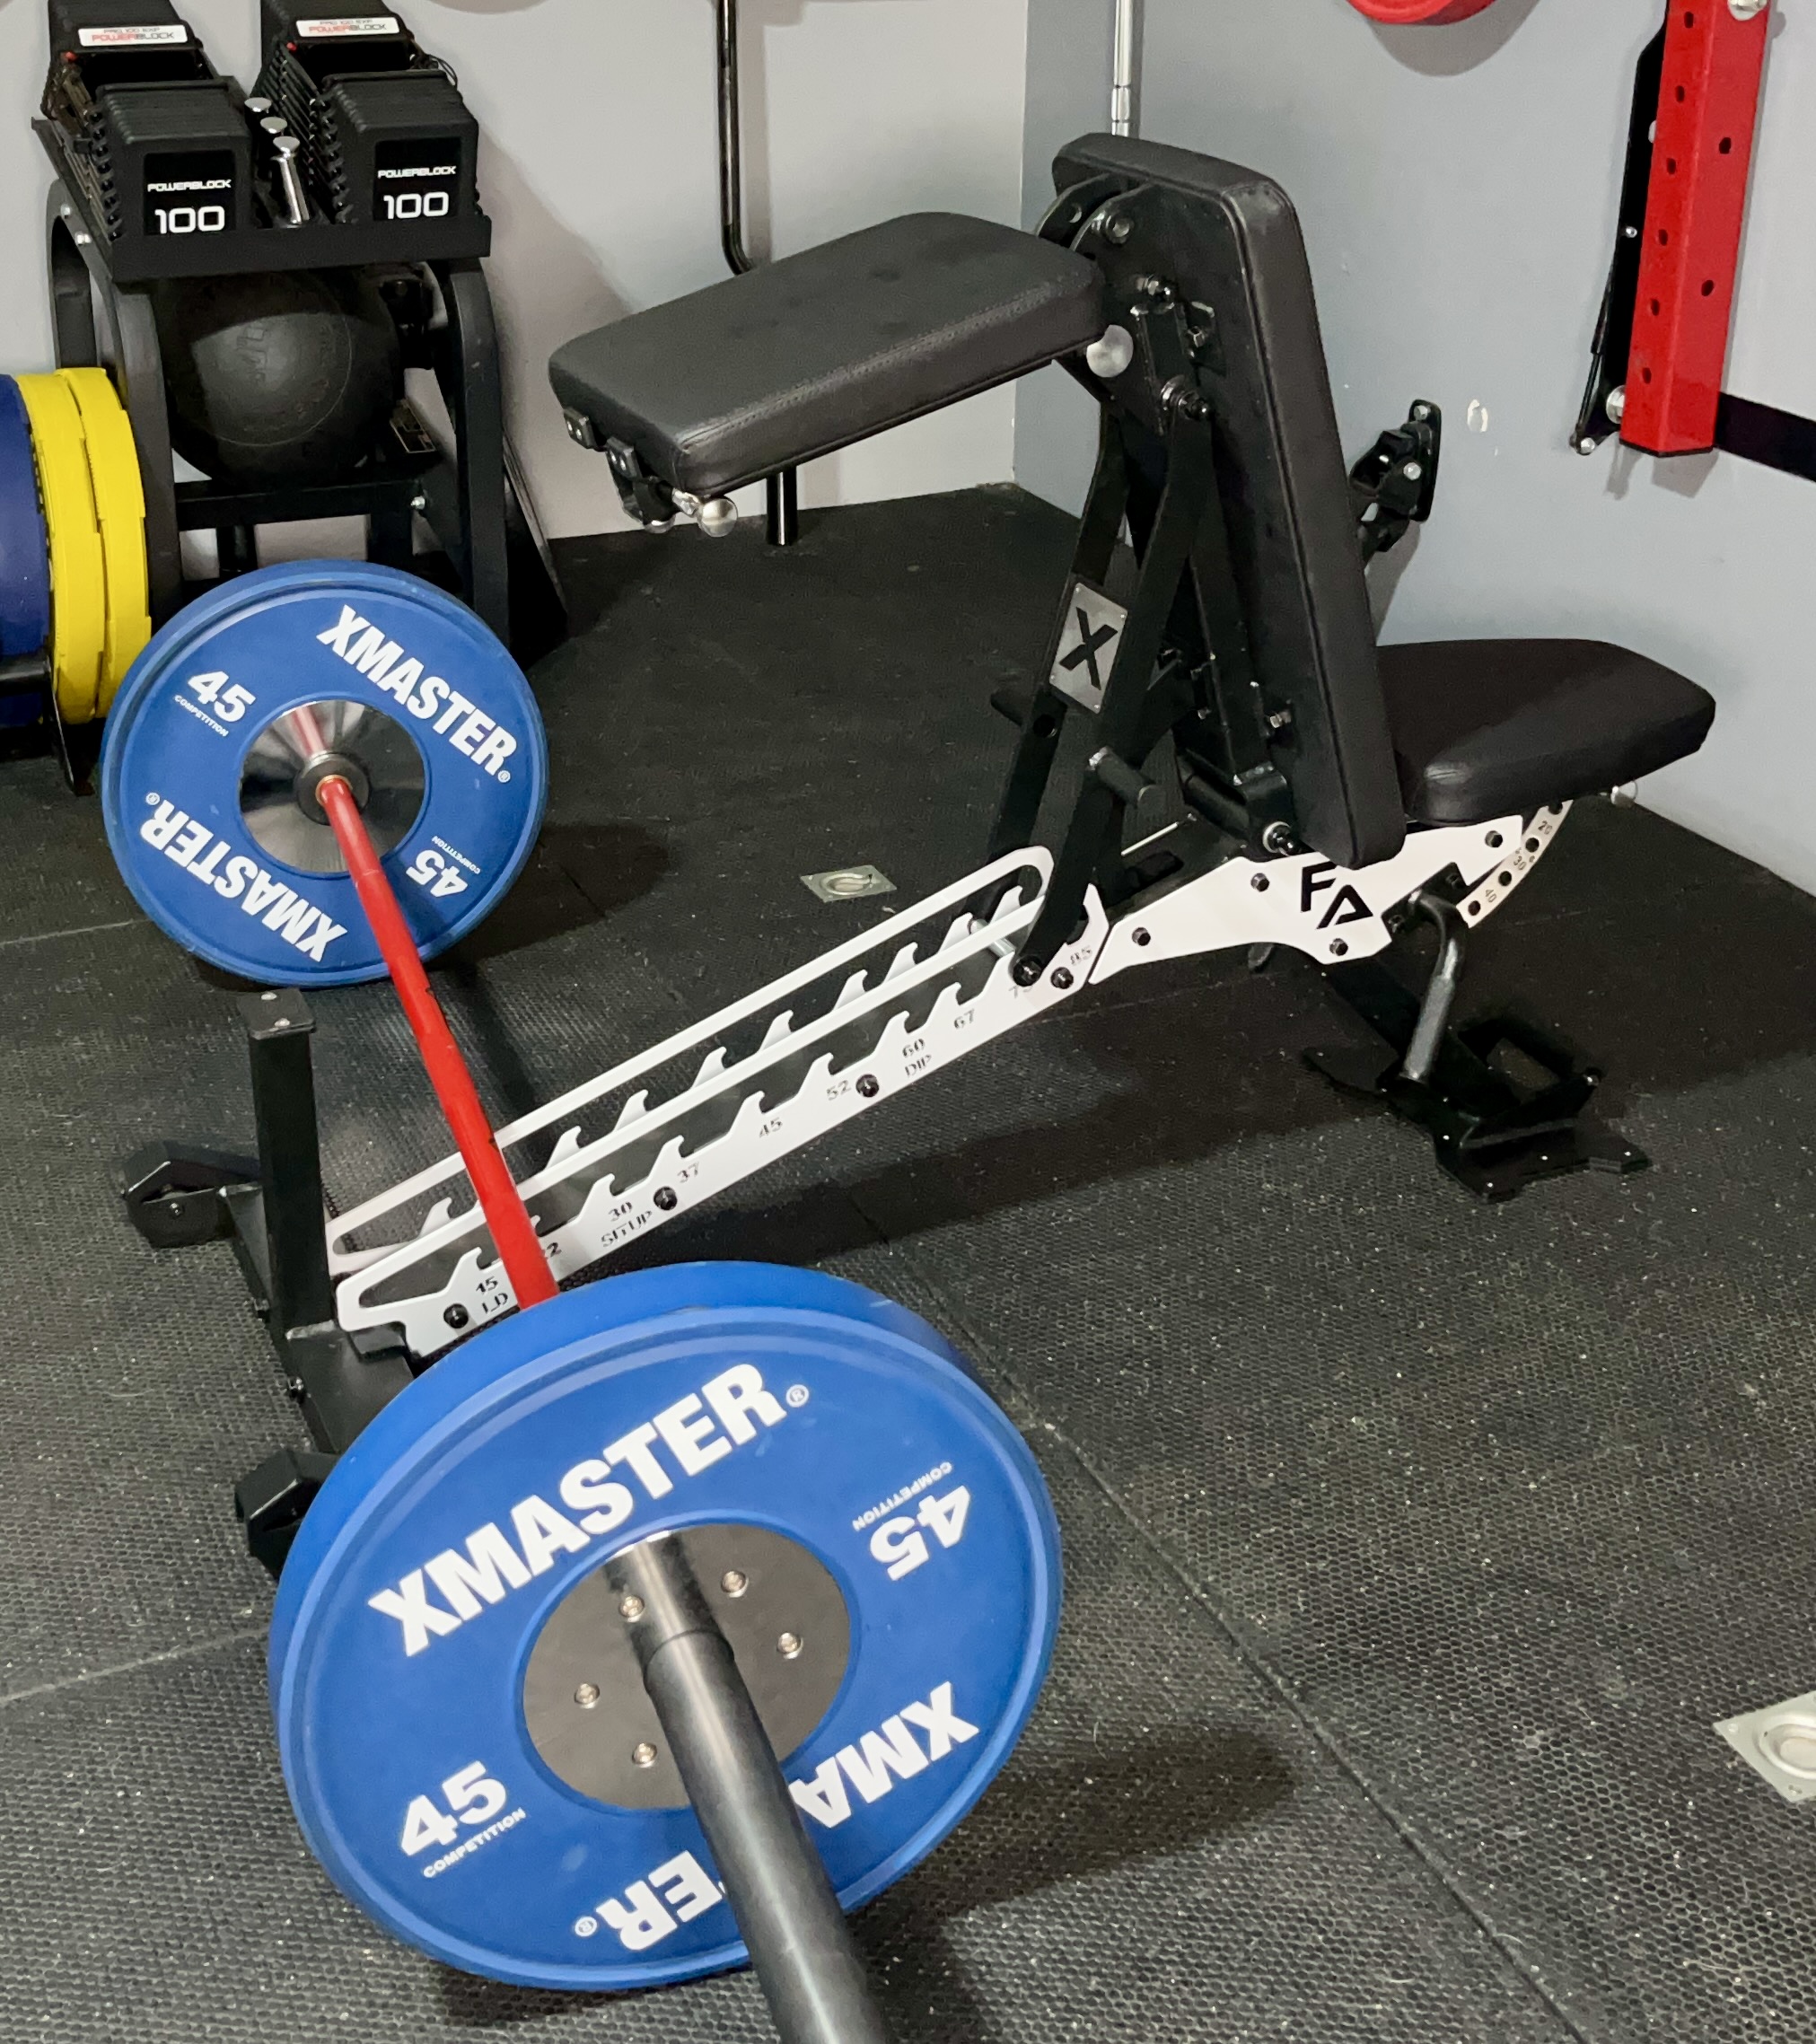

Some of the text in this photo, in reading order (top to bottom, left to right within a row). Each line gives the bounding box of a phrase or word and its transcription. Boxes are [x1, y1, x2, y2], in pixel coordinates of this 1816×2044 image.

[92, 32, 175, 42] POWERBLOCK
[308, 23, 387, 33] POWERBLOCK
[377, 165, 456, 179] POWERBLOCK
[147, 179, 232, 192] POWERBLOCK
[384, 191, 449, 219] 100
[155, 206, 225, 233] 100
[1059, 607, 1118, 690] X
[188, 671, 257, 723] 45
[174, 694, 229, 737] COMPETITION
[1538, 820, 1553, 835] 20
[431, 836, 481, 874] COMPETITION
[405, 849, 469, 898] 45
[1485, 889, 1497, 903] 40
[953, 1008, 975, 1030] 67
[902, 1039, 925, 1058] 60
[905, 1054, 932, 1077] DIP
[826, 1080, 851, 1101] 52
[759, 1117, 784, 1138] 45
[677, 1162, 699, 1184] 37
[609, 1202, 633, 1222] 30
[475, 1275, 498, 1294] 15
[481, 1292, 509, 1314] LD
[852, 1461, 953, 1531] COMPETITION
[868, 1485, 972, 1582] 45
[399, 1760, 508, 1857] 45
[422, 1808, 527, 1878] COMPETITION
